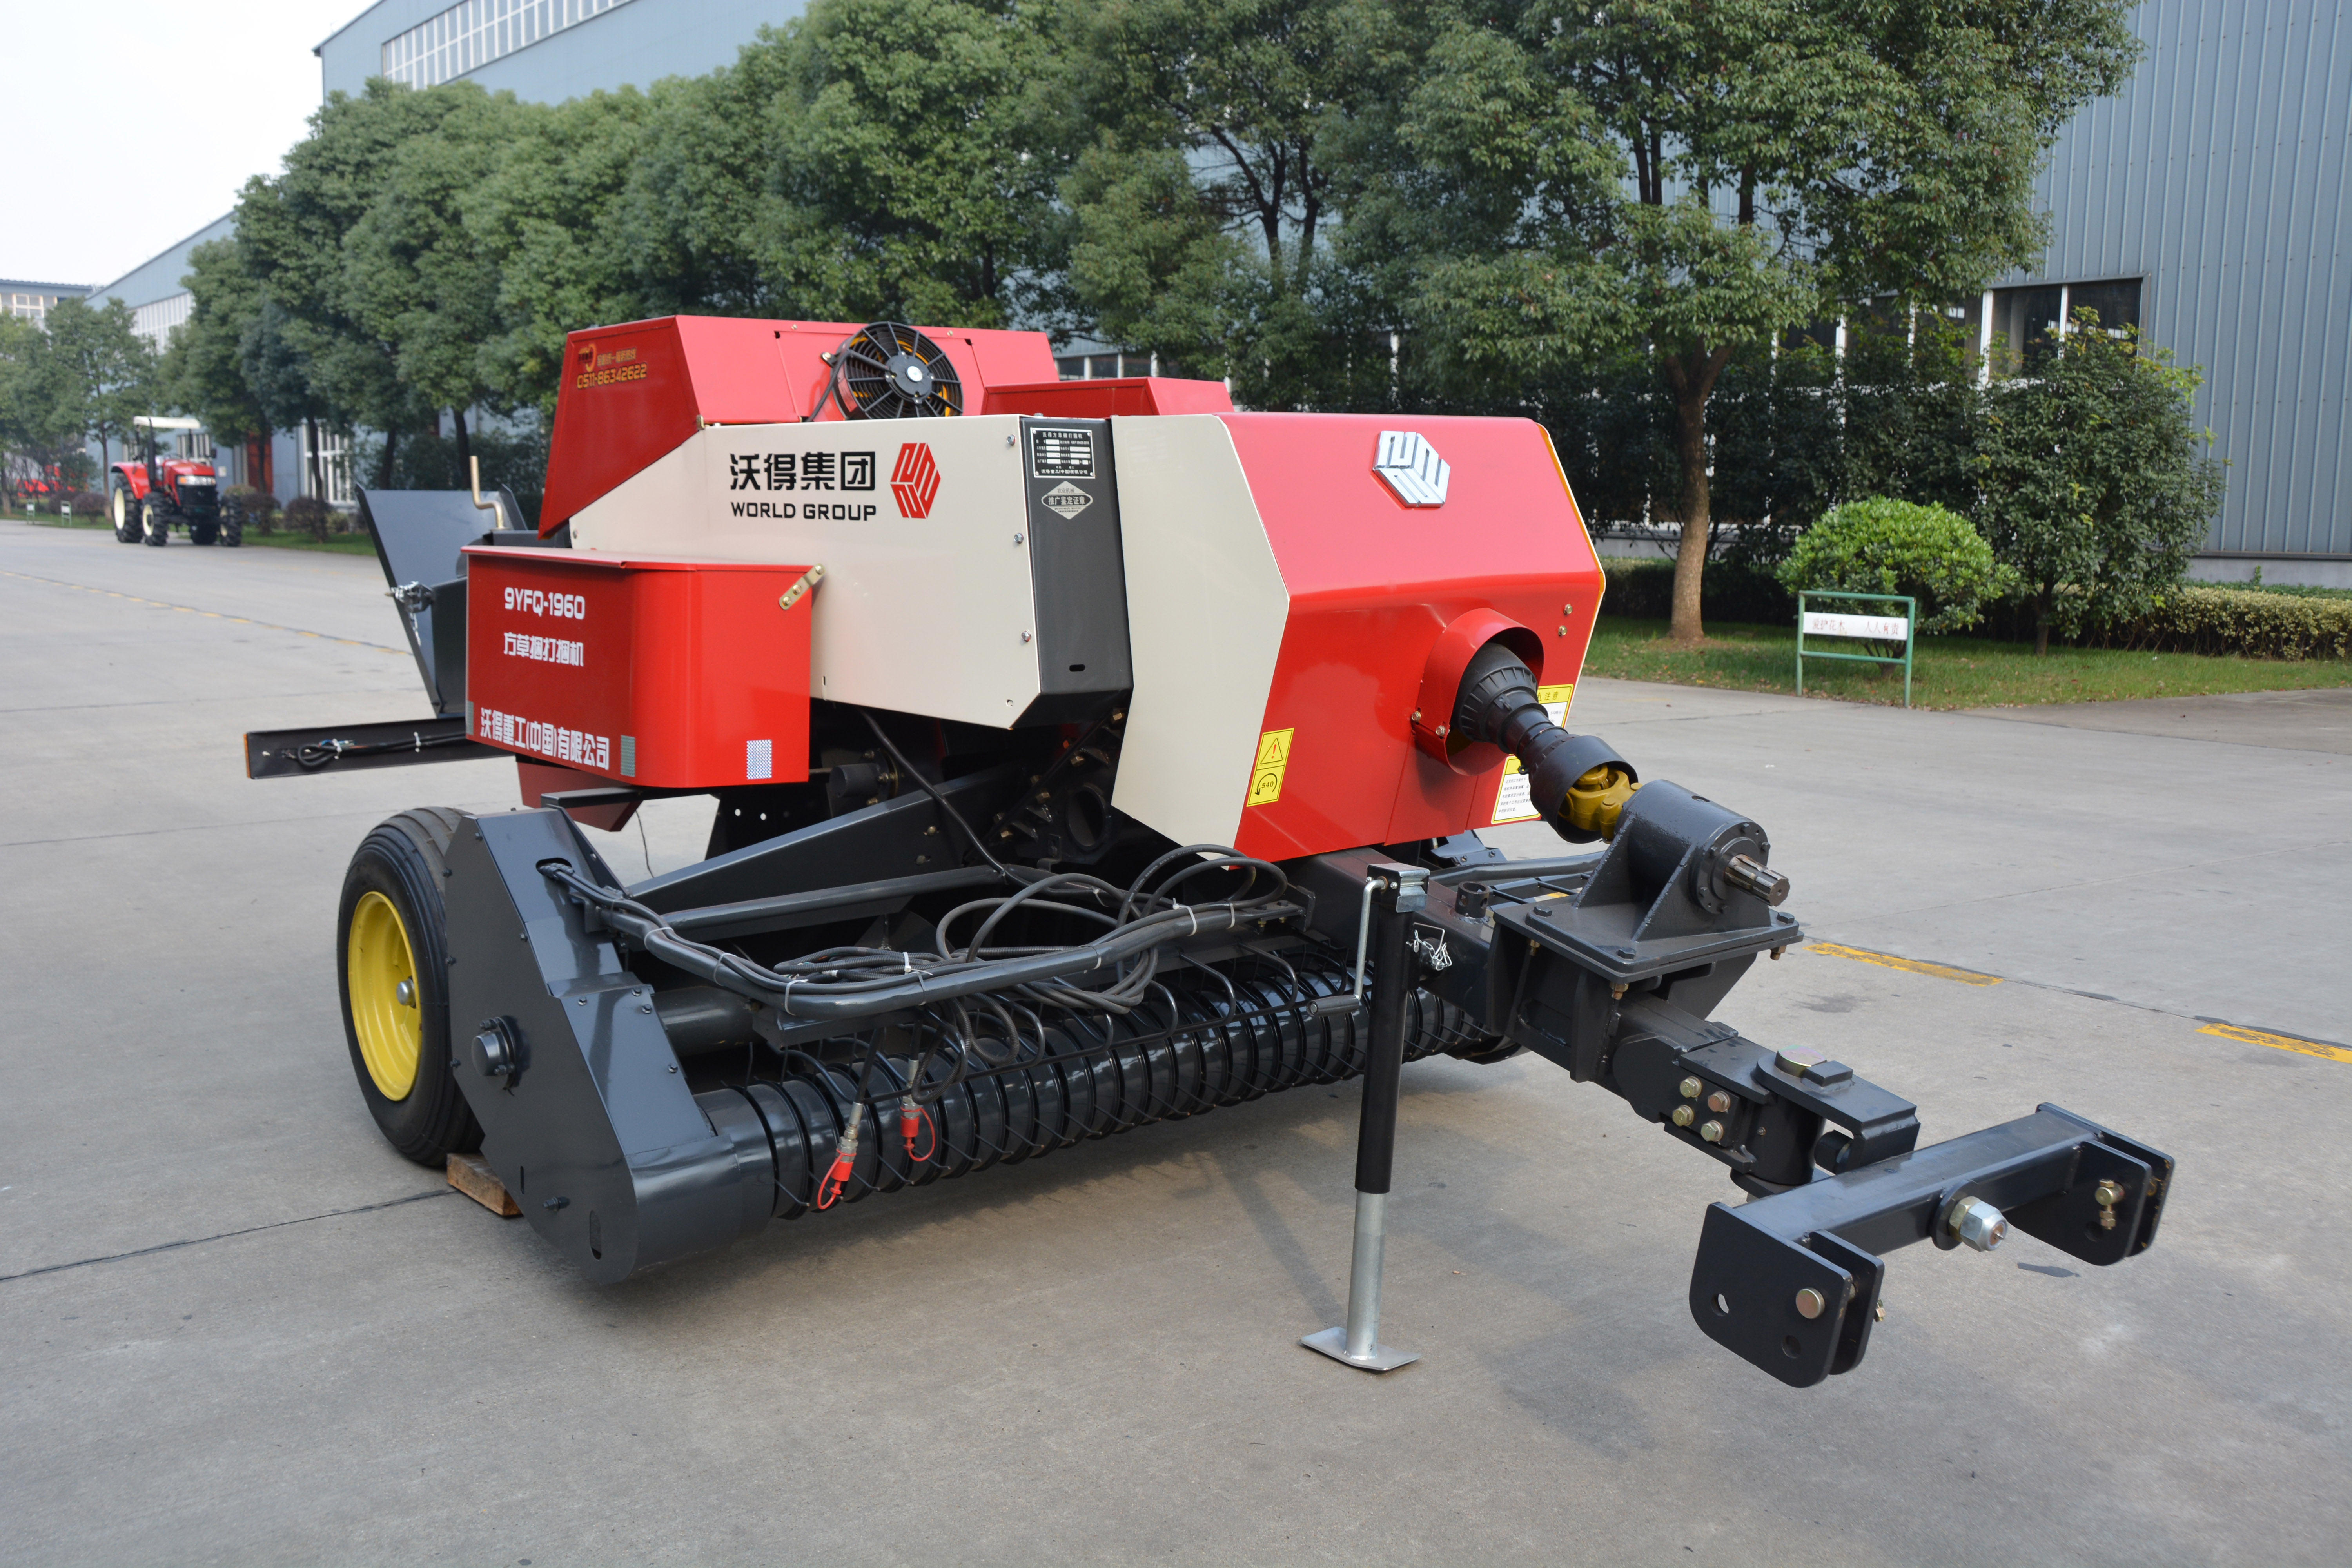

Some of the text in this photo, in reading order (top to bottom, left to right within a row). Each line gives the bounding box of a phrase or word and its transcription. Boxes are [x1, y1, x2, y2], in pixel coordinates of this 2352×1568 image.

[730, 451, 875, 491] 沃得集团
[731, 502, 876, 521] WORLD GROUP
[1048, 496, 1085, 505] 推广鉴定证章
[504, 587, 585, 620] 9YFQ-1960
[503, 632, 584, 667] 方草捆打捆机
[1545, 691, 1559, 701] 注意
[480, 707, 610, 771] 沃得重工(中国)有限公司
